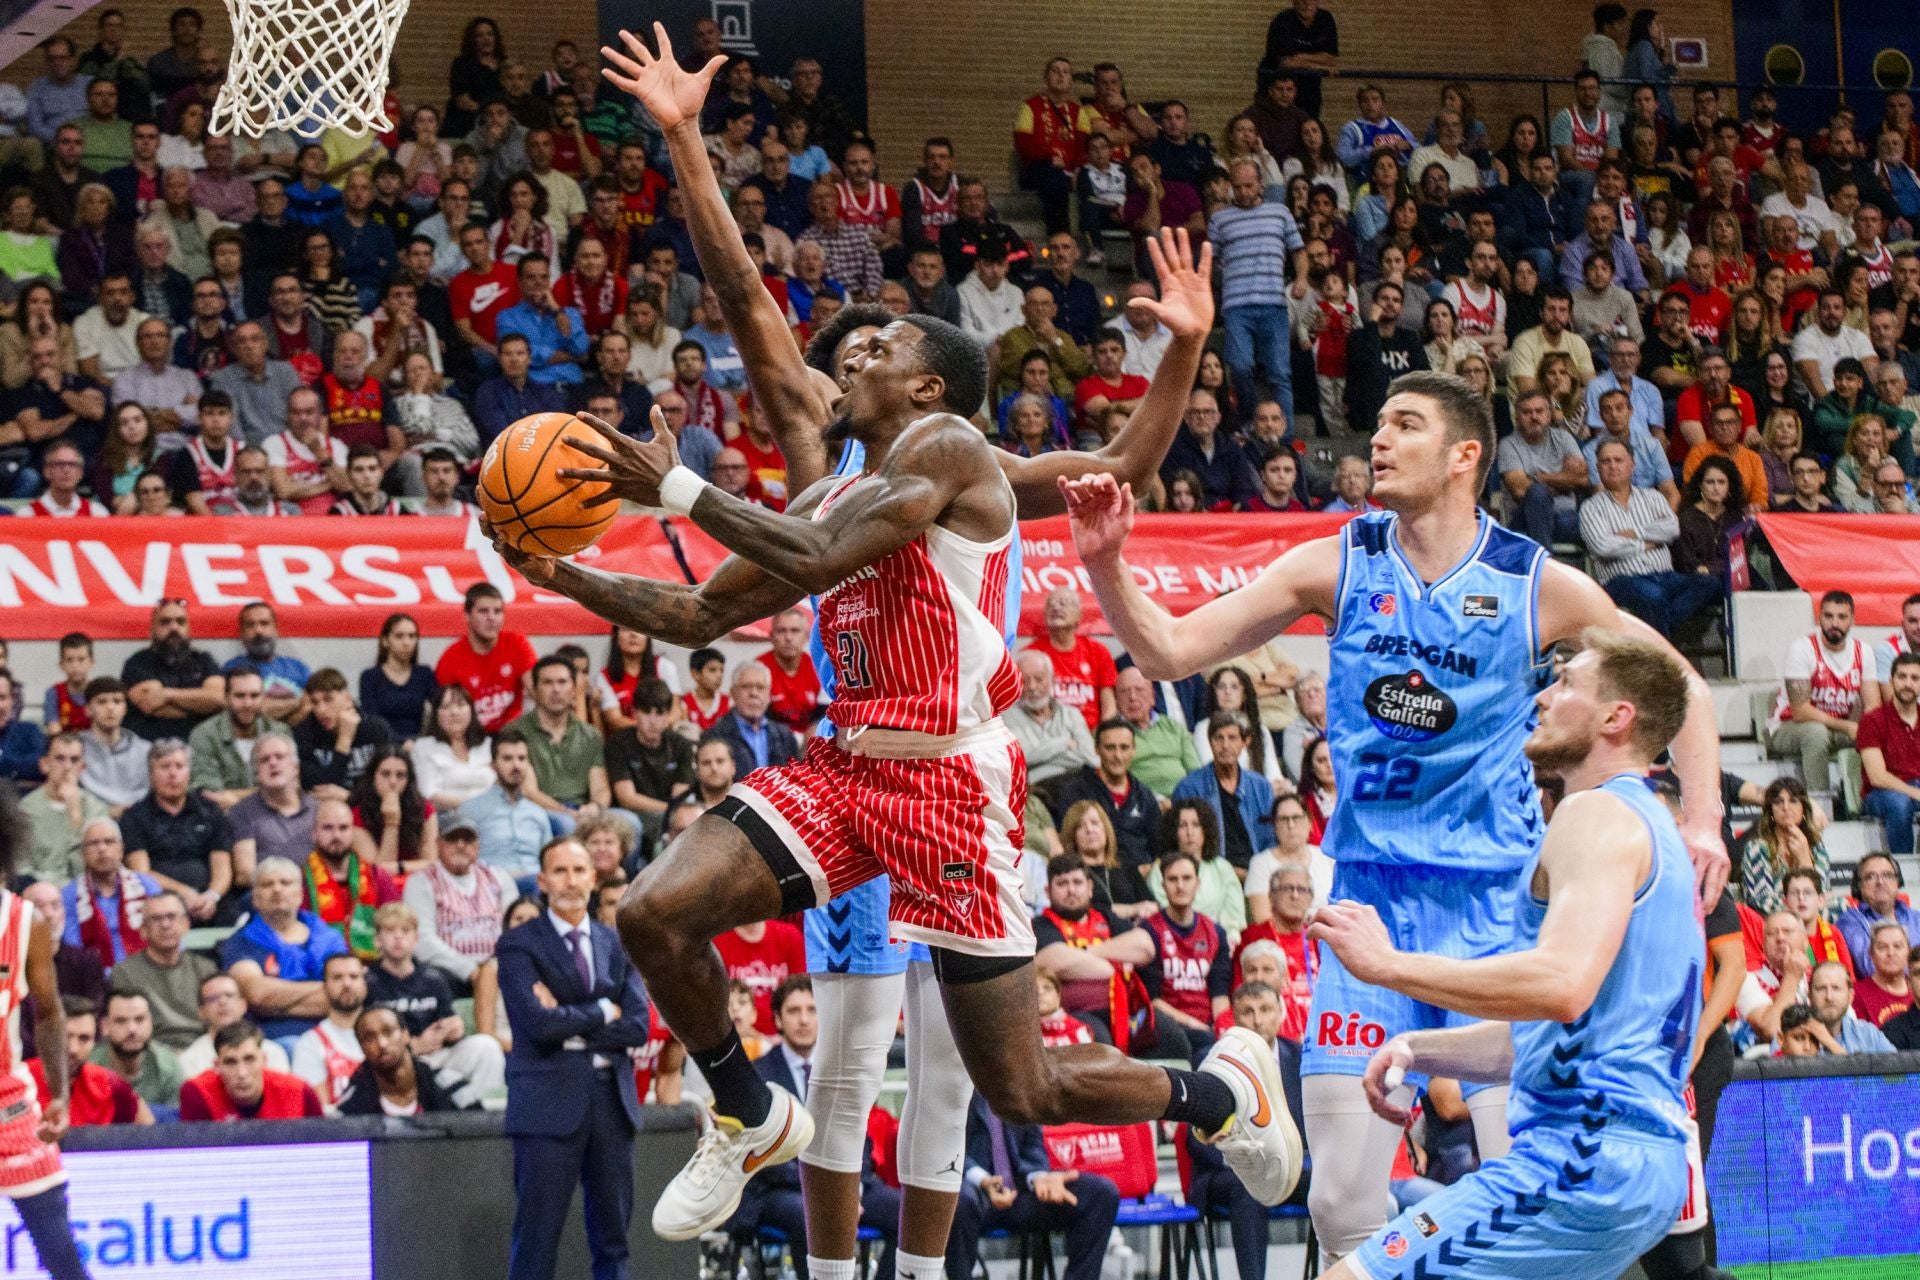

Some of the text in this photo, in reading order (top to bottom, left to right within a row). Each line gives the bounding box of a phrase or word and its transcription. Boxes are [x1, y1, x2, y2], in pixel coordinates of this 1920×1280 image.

[837, 630, 873, 689] 31
[1364, 633, 1478, 680] BREOGÁN
[1377, 701, 1438, 728] Galicia
[1379, 684, 1443, 712] Estrella
[1352, 751, 1421, 802] 22
[945, 869, 967, 879] acb
[1317, 1011, 1387, 1049] Río
